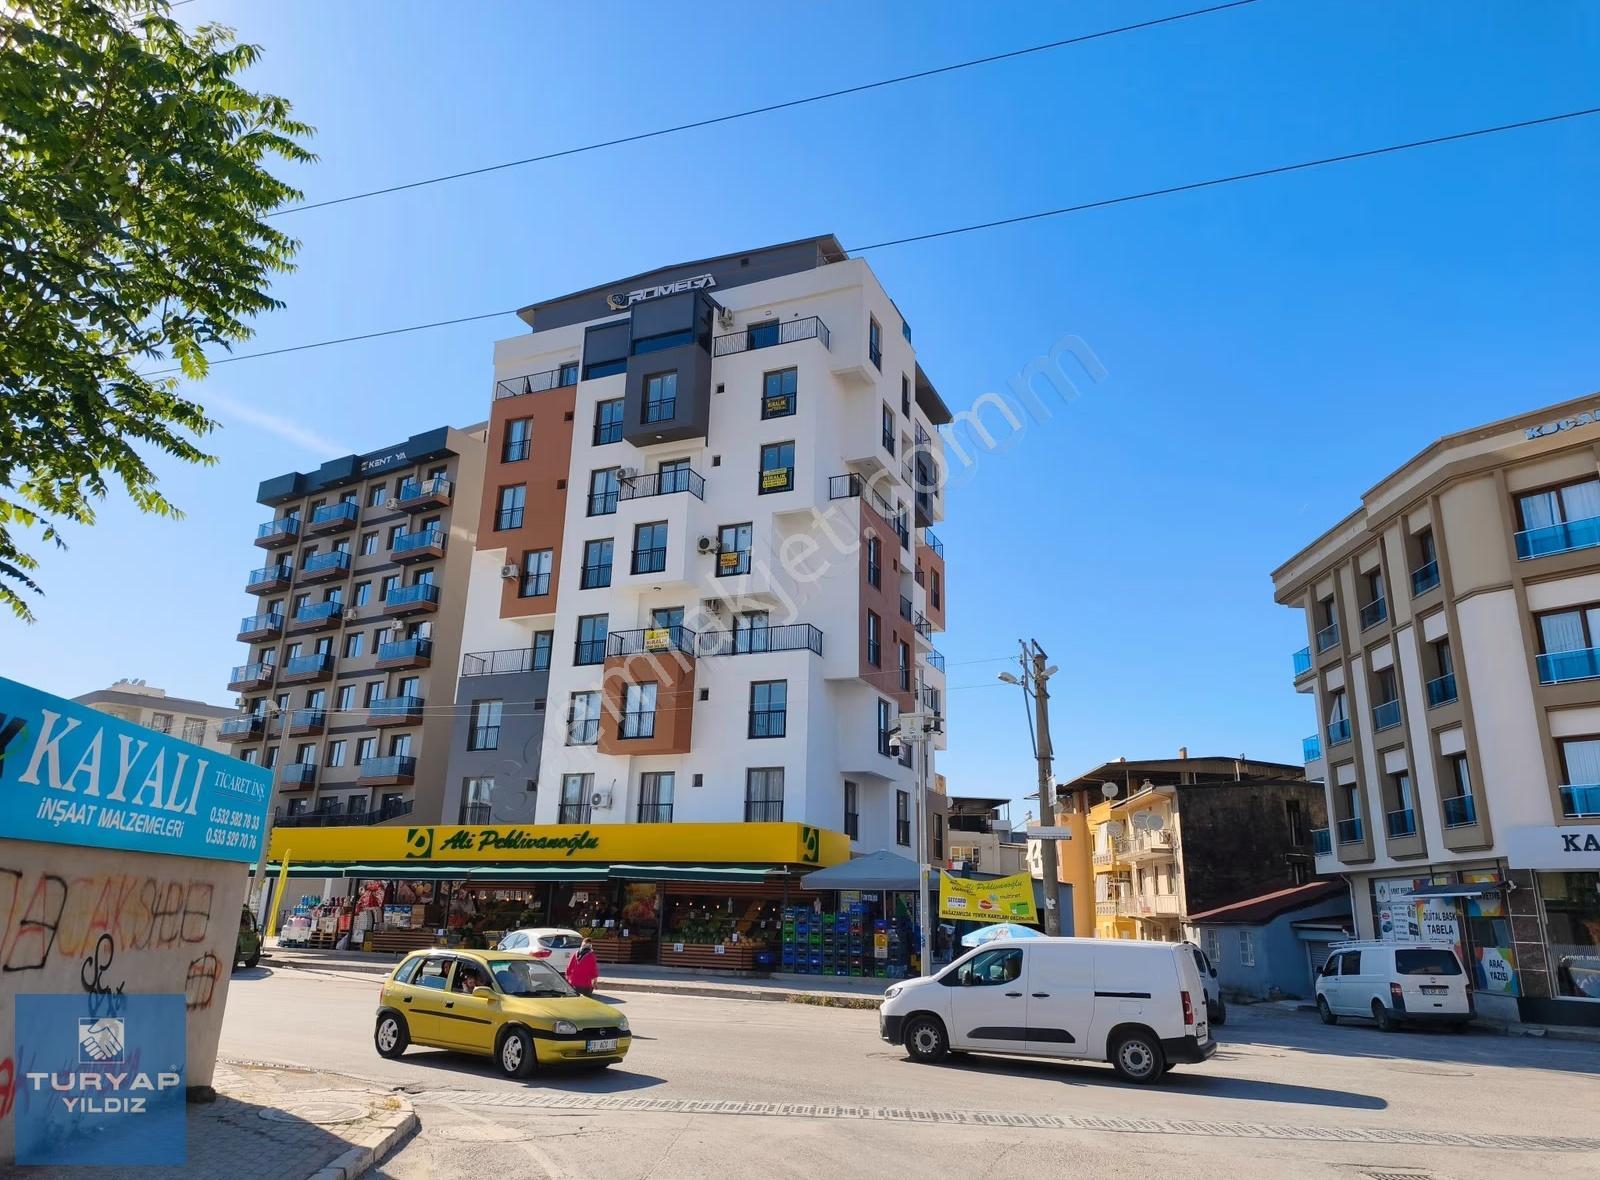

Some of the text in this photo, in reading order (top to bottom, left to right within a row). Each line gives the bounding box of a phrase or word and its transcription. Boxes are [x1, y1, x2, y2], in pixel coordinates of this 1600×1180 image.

[368, 455, 392, 469] KENT
[763, 473, 787, 482] KIRALIK
[18, 708, 209, 816] KAYALI
[214, 769, 252, 794] TİCARET
[36, 797, 185, 839] İNŞAAT MALZEMELERİ
[439, 828, 599, 856] Ali Pehlivanoğlu
[1427, 924, 1454, 935] TABELA
[1489, 959, 1504, 971] ARAÇ
